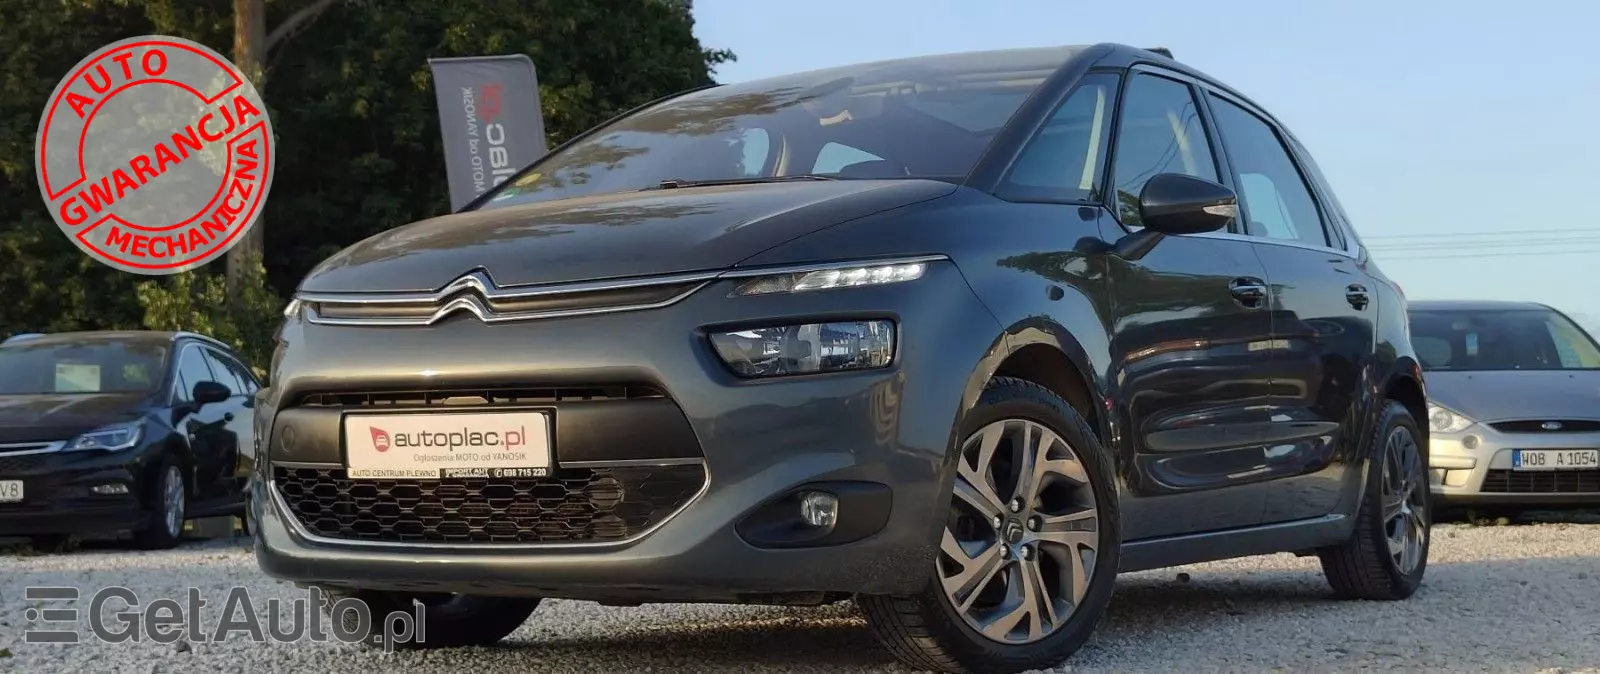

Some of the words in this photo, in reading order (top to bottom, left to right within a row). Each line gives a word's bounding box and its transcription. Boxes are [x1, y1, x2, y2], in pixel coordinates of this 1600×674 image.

[394, 425, 526, 451] autoplac.pl
[455, 453, 479, 461] MOTO
[480, 453, 491, 461] od
[492, 452, 527, 461] YANOSIK
[1521, 452, 1545, 466] WOB
[1556, 452, 1564, 466] A
[1569, 451, 1596, 465] 1054
[352, 469, 371, 477] AUTO
[372, 469, 404, 477] CENTRUM
[406, 469, 437, 477] PLEWNO
[518, 468, 532, 477] 715
[533, 468, 547, 476] 220
